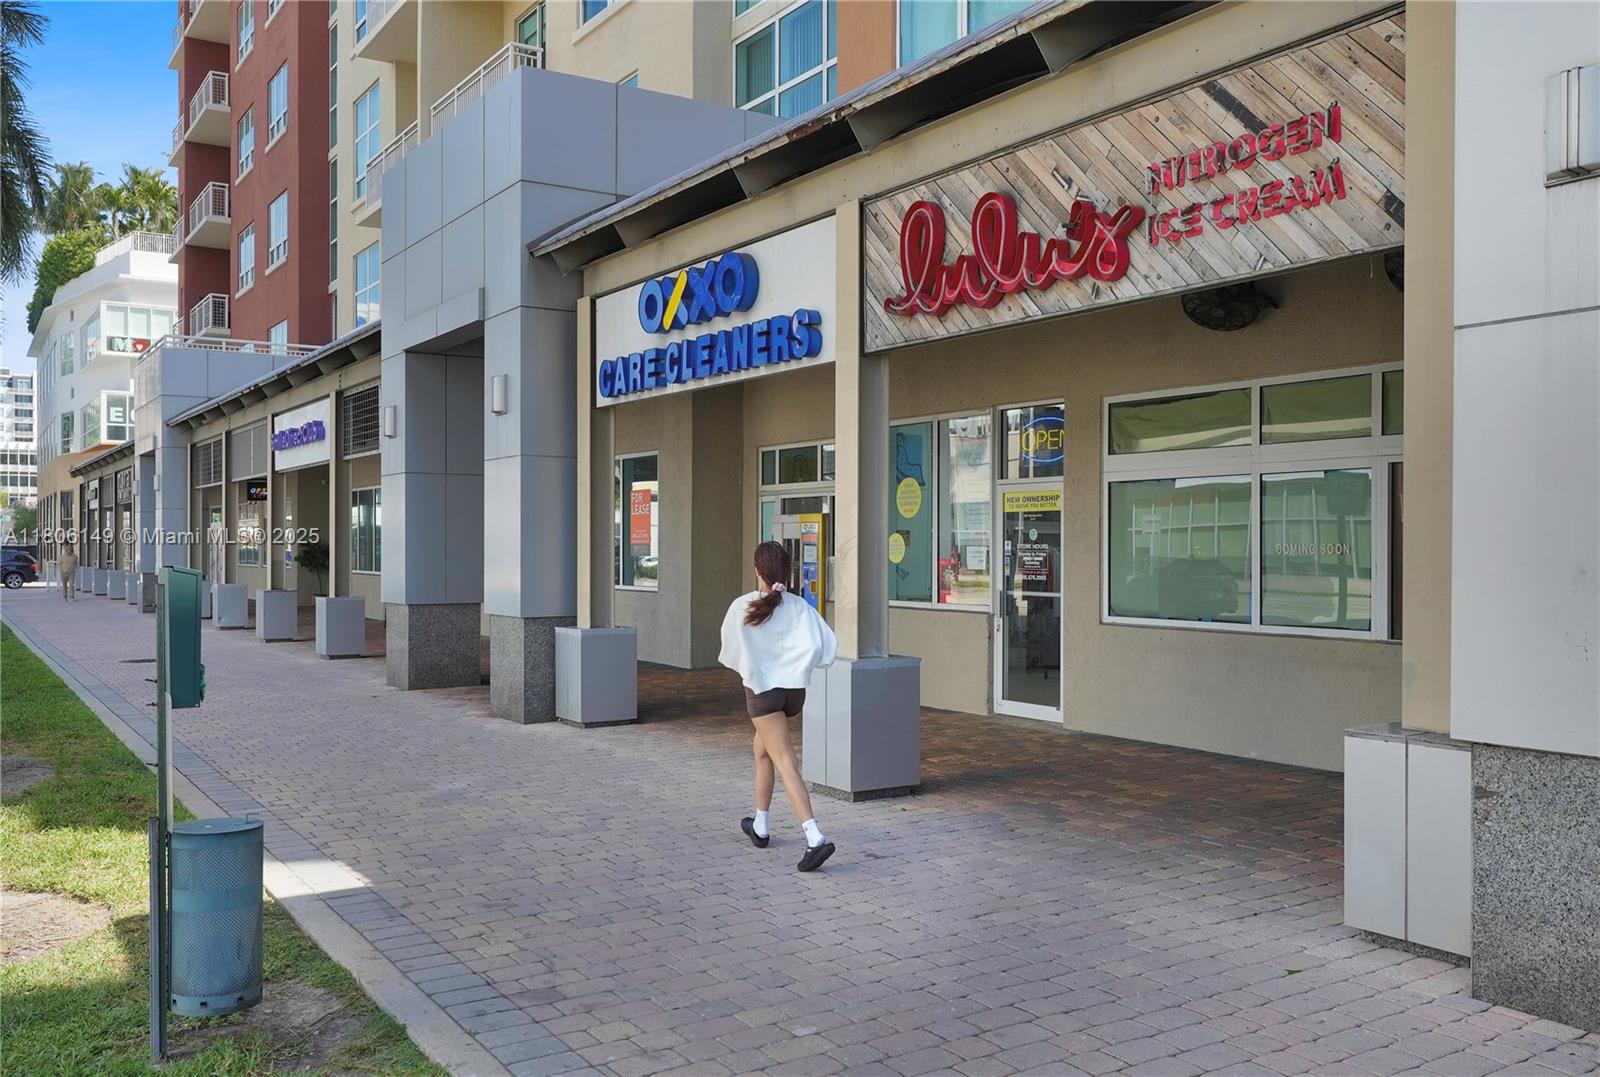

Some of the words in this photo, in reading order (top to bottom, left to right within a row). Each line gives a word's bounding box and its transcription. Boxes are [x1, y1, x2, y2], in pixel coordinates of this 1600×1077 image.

[1146, 101, 1342, 195] NITROGEN
[1146, 202, 1204, 247] ICE
[1206, 157, 1347, 230] CREAM
[638, 251, 760, 334] OXXO
[599, 348, 667, 398] CARE
[665, 308, 823, 385] CLEANERS
[631, 492, 643, 504] FOR
[631, 503, 651, 516] LEASE
[1021, 494, 1060, 503] OWNERSHIP
[1275, 543, 1317, 555] COMING
[1319, 543, 1352, 555] SOON
